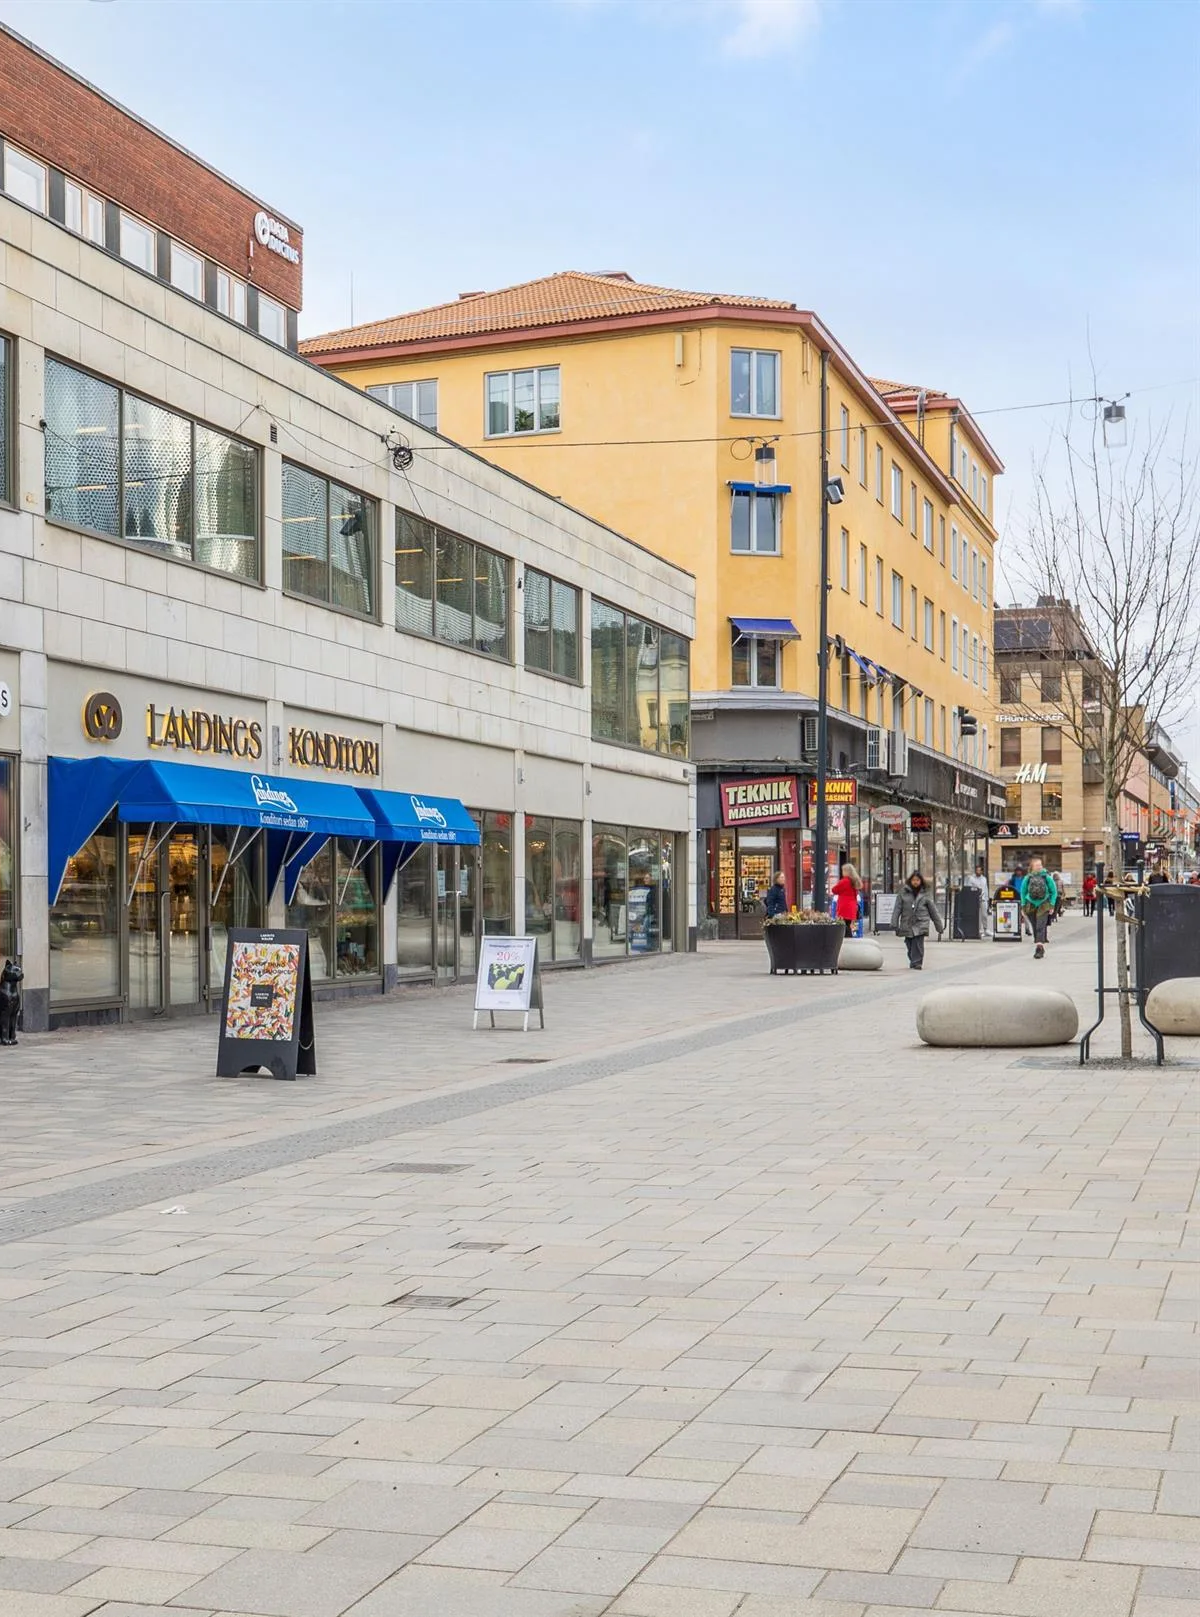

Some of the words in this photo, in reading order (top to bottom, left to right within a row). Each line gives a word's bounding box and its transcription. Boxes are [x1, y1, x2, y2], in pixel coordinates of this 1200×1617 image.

[147, 703, 262, 760] LANDINGS
[289, 726, 380, 776] KONDITORI
[1016, 763, 1048, 784] H&M
[725, 780, 792, 806] TEKNIK
[812, 781, 853, 793] TKNIK
[728, 801, 794, 820] MAGASINET
[1019, 823, 1050, 837] ubus
